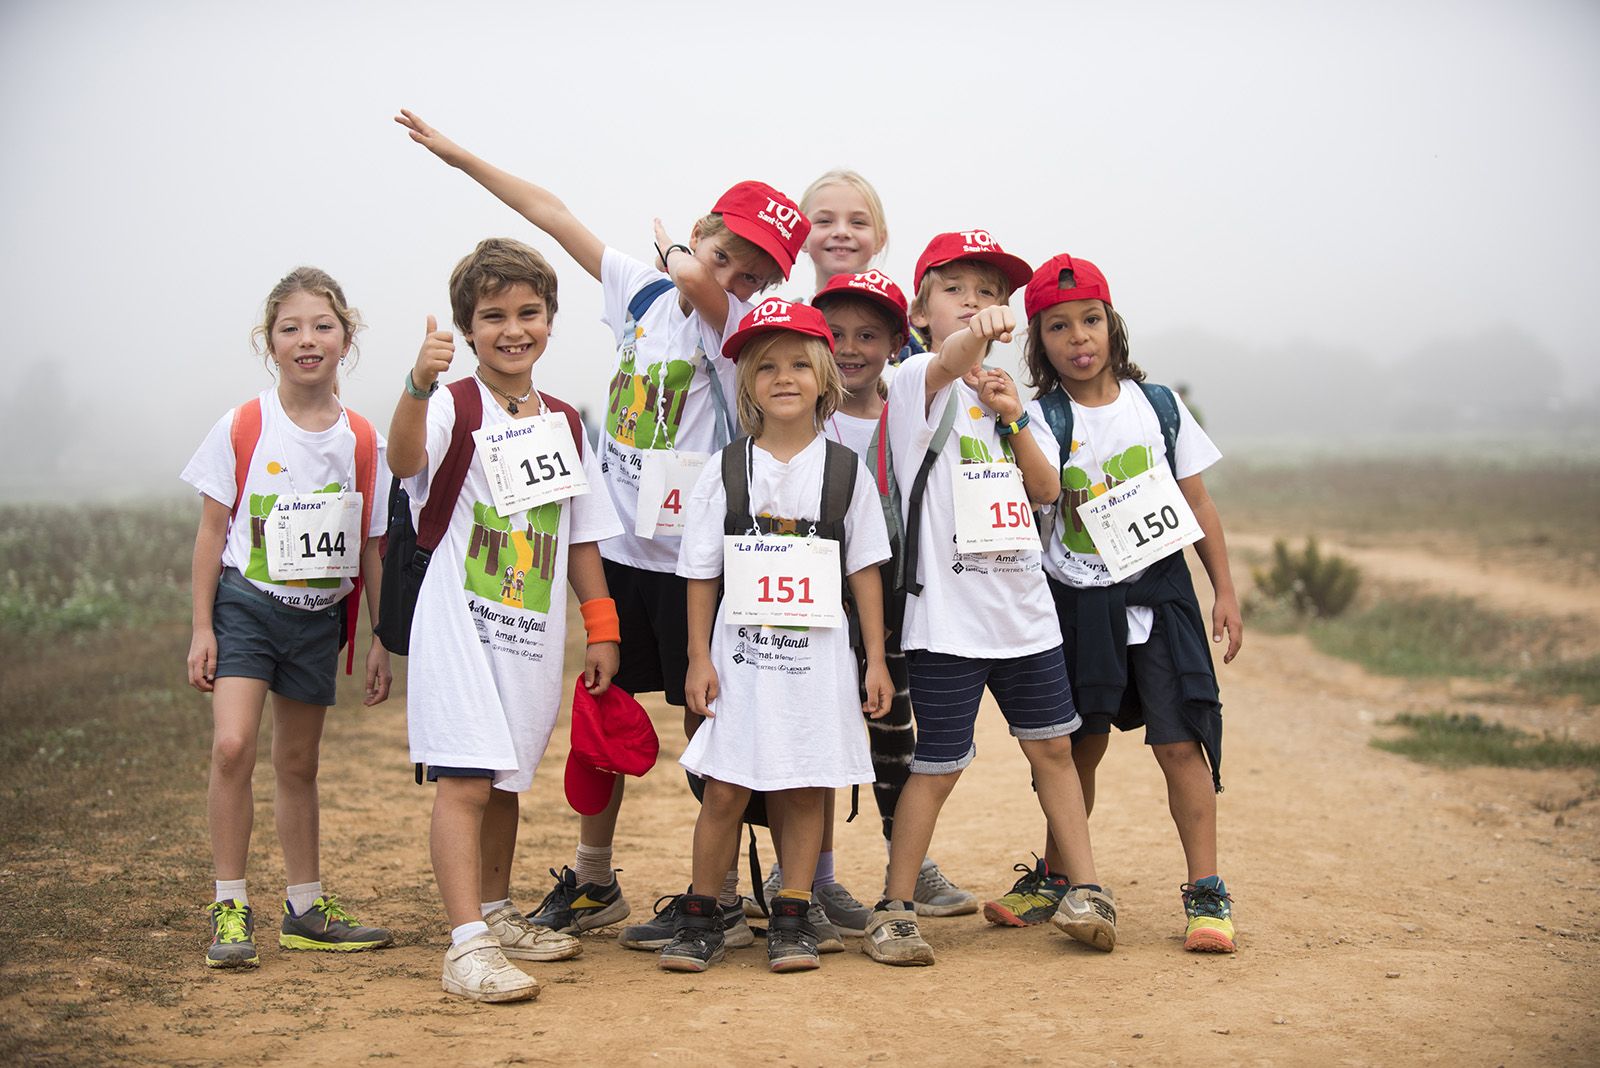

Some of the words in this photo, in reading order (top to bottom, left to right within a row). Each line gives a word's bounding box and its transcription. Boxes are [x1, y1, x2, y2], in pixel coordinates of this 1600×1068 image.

[765, 196, 802, 230] TOT
[854, 270, 893, 291] TOT
[752, 300, 793, 322] TOT
[520, 451, 571, 487] 151
[661, 488, 682, 515] 4
[990, 501, 1031, 528] 150
[1128, 504, 1180, 548] 150
[299, 531, 346, 558] 144
[757, 575, 814, 604] 151
[478, 605, 515, 627] Marxa
[770, 634, 809, 650] Infantil
